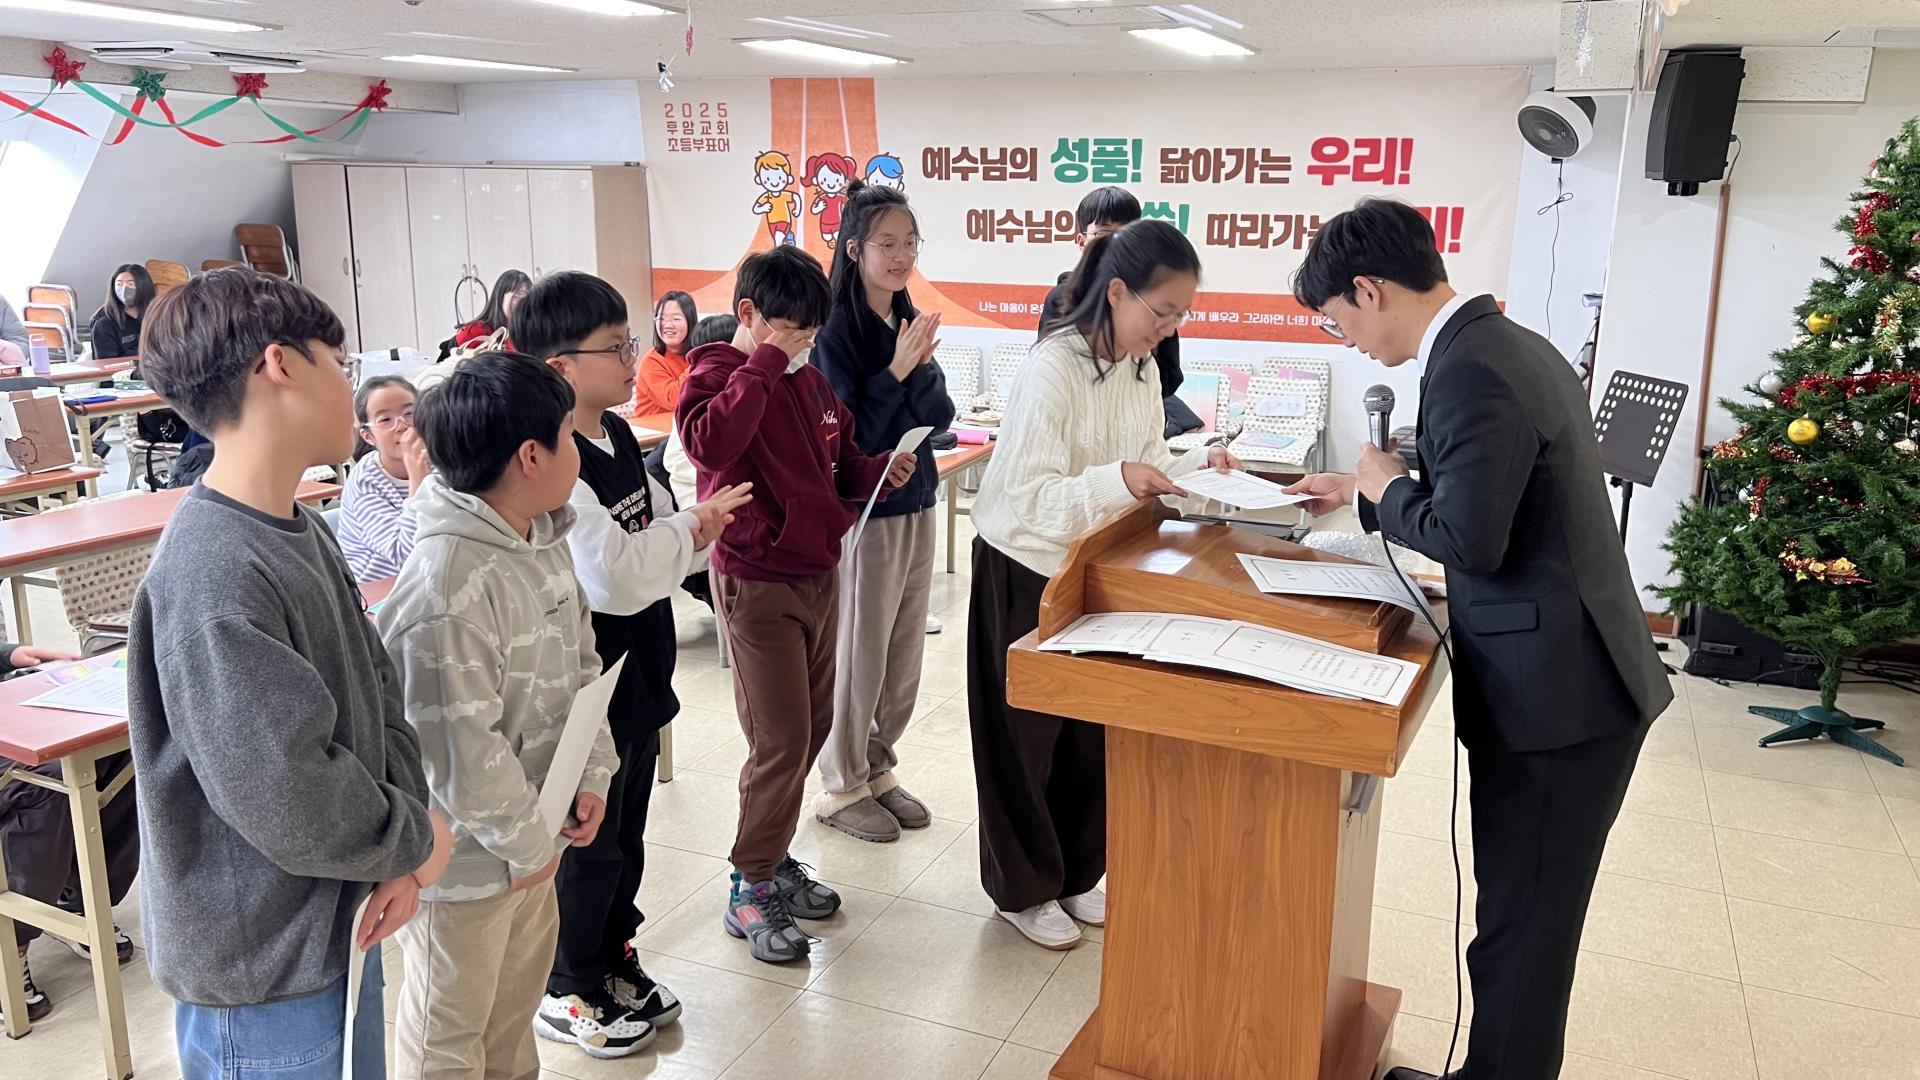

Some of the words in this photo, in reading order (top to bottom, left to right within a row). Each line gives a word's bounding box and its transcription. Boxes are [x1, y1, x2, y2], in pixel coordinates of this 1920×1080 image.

[664, 102, 728, 118] 2025
[922, 147, 1037, 181] 예수님의
[1051, 137, 1143, 183] 성품!
[1160, 147, 1292, 184] 닮아가는
[1307, 136, 1414, 186] 우리!
[966, 208, 1082, 243] 예수님의
[978, 301, 998, 312] 나는
[1000, 302, 1027, 313] 마음이
[1209, 311, 1239, 323] 배우라
[1242, 312, 1284, 326] 그리하면
[1287, 314, 1309, 326] 너희
